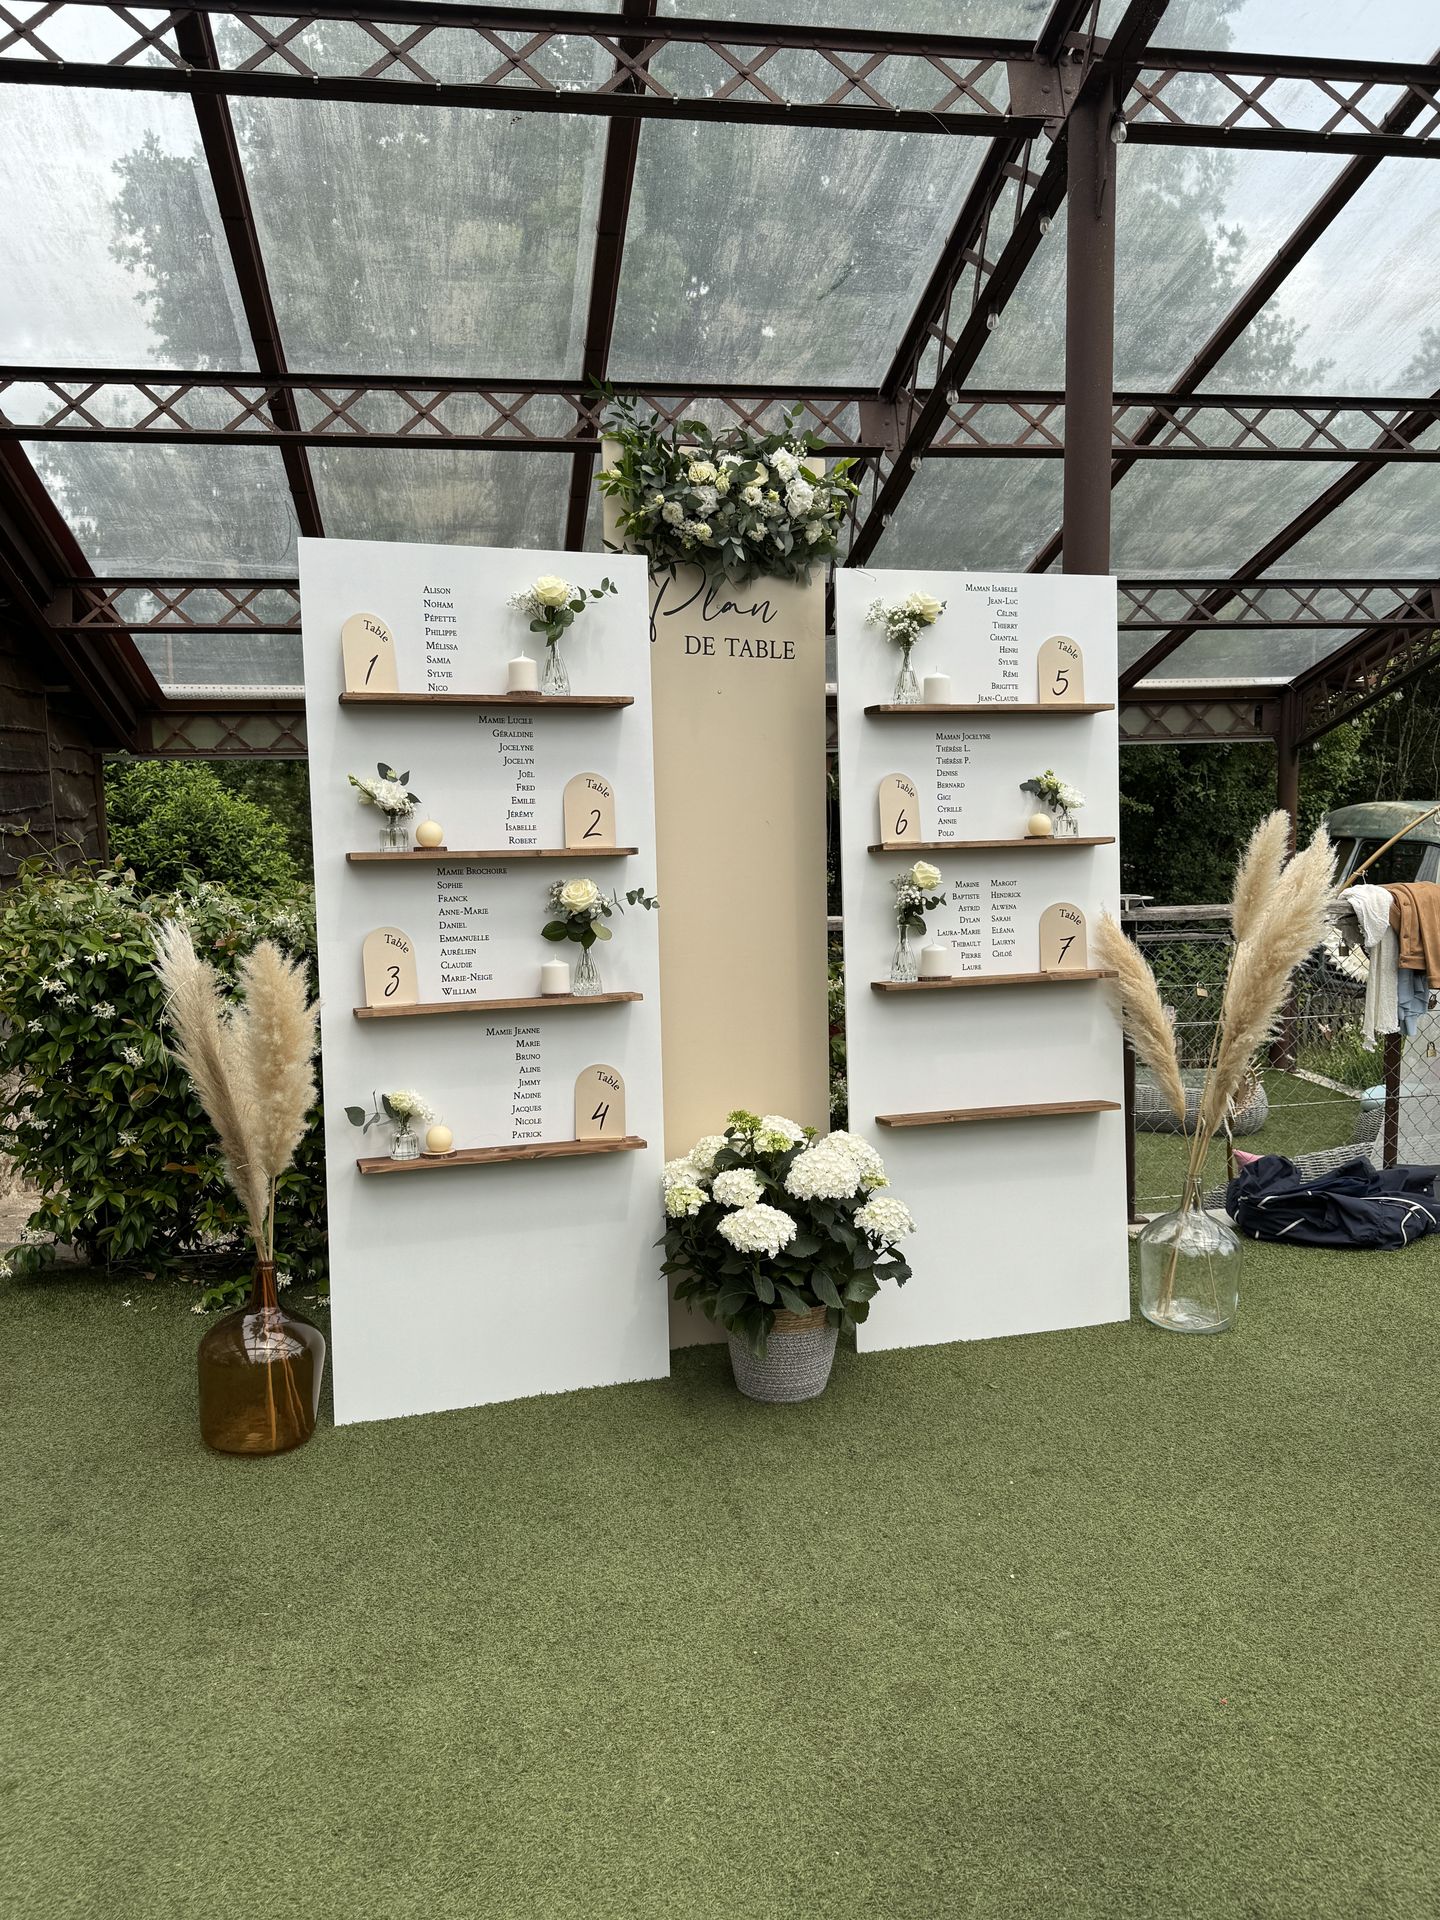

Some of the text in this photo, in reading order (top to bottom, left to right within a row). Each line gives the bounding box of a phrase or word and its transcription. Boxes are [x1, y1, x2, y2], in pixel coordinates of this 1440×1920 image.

[423, 585, 451, 594] ALISON
[965, 584, 990, 592] MAMAN
[424, 600, 453, 609] NOHAM
[648, 561, 778, 642] Plan
[987, 597, 1018, 606] JEAN-LUC
[424, 612, 456, 623] PÉPETTE
[997, 609, 1018, 617] CÉLINE
[363, 619, 389, 643] Table
[425, 627, 457, 636] PHILIPPE
[990, 634, 1018, 642] CHANTAL
[426, 641, 458, 650] MÉLISSA
[685, 636, 796, 659] DE TABLE
[1058, 641, 1079, 660] Table
[426, 656, 451, 664] SAMIA
[998, 658, 1018, 666] SYLVIE
[365, 654, 378, 685] 1
[427, 669, 453, 678] SYLVIE
[1003, 670, 1018, 678] RÉMI
[1052, 669, 1069, 696] 5
[428, 683, 448, 692] NICO
[977, 695, 1018, 703] JEAN-CLAUDE
[479, 716, 533, 724] MAMIE LUCILE
[492, 729, 534, 738] GÉRALDINE
[961, 733, 991, 741] JOCELYNE
[498, 743, 534, 752] JOCELYNE
[503, 756, 534, 766] JOCELYN
[516, 784, 535, 792] FRED
[586, 778, 610, 798] Table
[896, 779, 915, 798] Table
[511, 796, 536, 805] EMILIE
[506, 810, 534, 819] JÉRÉMY
[582, 809, 602, 839] 2
[895, 809, 908, 835] 6
[505, 823, 537, 831] ISABELLE
[508, 836, 537, 844] ROBERT
[437, 867, 464, 876] MAMIE
[437, 881, 463, 889] SOPHIE
[991, 879, 1017, 887] MARGOT
[438, 894, 468, 902] FRANCK
[439, 907, 488, 916] ANNE-MARIE
[958, 904, 980, 912] ASTRID
[991, 903, 1017, 911] ALWENA
[959, 916, 980, 924] DYLAN
[1059, 909, 1082, 926] Table
[439, 921, 467, 929] DANIEL
[937, 928, 981, 937] LAURA-MARIE
[440, 934, 490, 942] EMMANUELLE
[384, 933, 409, 954] Table
[951, 940, 981, 948] THIBAULT
[440, 947, 477, 956] AURÉLIEN
[992, 950, 1012, 958] CHLOÉ
[1057, 936, 1076, 964] 7
[440, 960, 472, 969] CLAUDIE
[384, 966, 400, 997] 3
[441, 973, 493, 982] MARIE-NEIGE
[442, 987, 477, 996] WILLIAM
[486, 1026, 540, 1036] MAMIE JEANNE
[516, 1040, 540, 1048] MARIE
[516, 1052, 541, 1060] BRUNO
[519, 1066, 541, 1074] ALINE
[518, 1078, 541, 1088] JIMMY
[597, 1070, 620, 1092] Table
[514, 1092, 541, 1100] NADINE
[511, 1104, 542, 1114] JACQUES
[591, 1101, 610, 1130] 4
[515, 1117, 542, 1125] NICOLE
[512, 1130, 542, 1138] PATRICK
